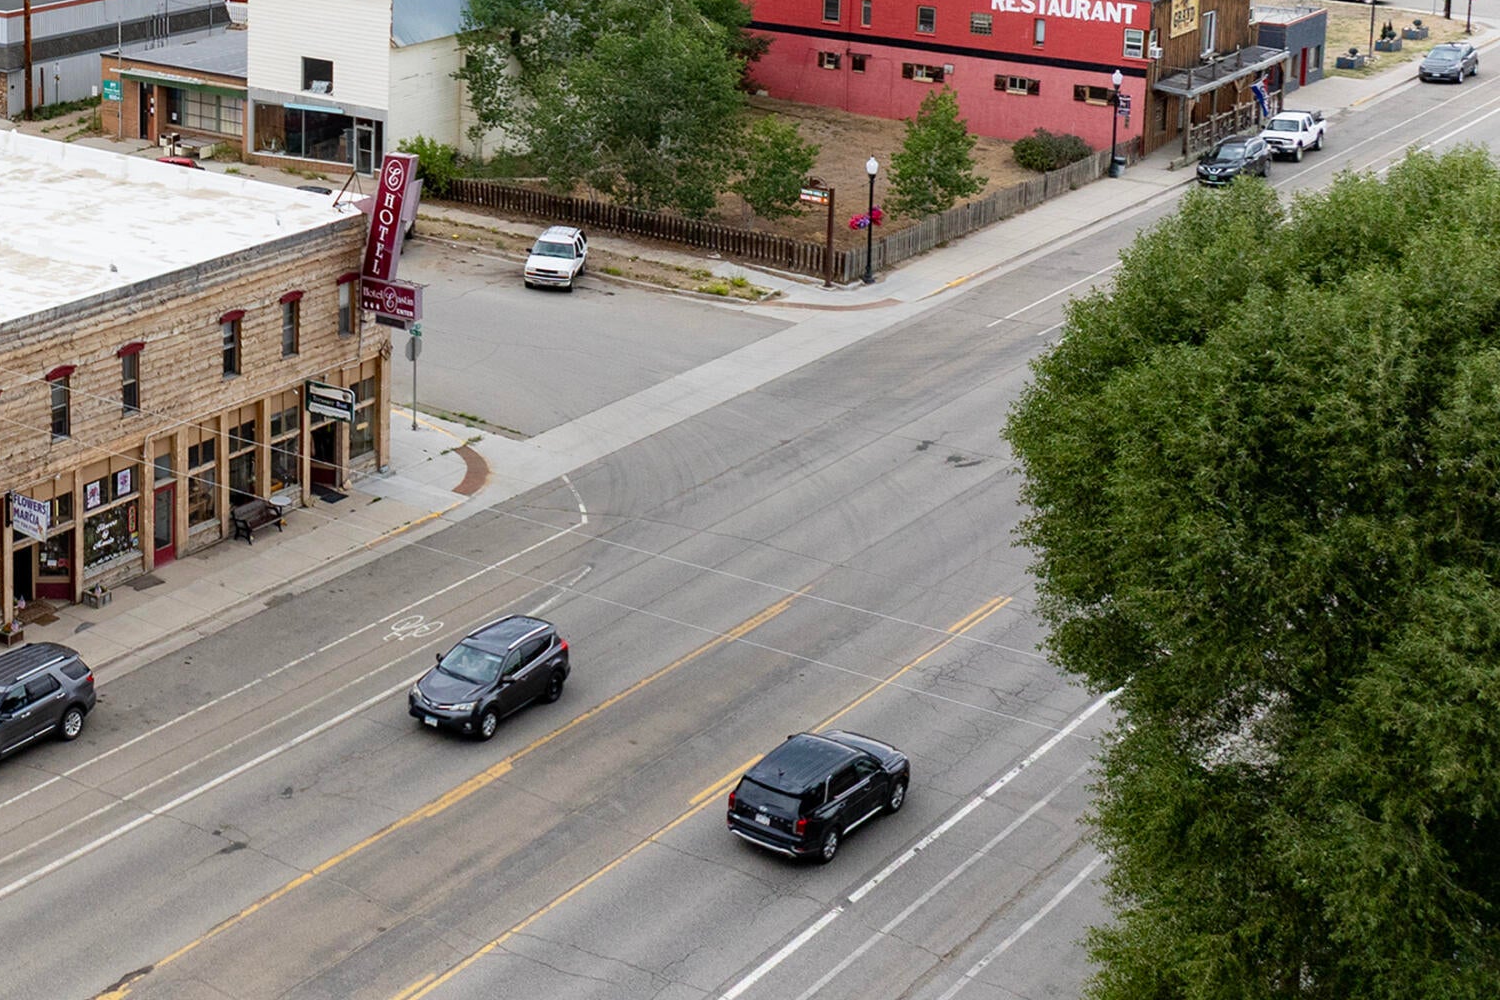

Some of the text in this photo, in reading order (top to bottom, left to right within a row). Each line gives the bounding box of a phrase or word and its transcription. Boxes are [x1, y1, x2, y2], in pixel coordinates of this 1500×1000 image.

[372, 192, 395, 275] HOTEL
[363, 286, 384, 300] Hotel
[13, 494, 46, 515] FLOWERS
[13, 507, 40, 525] MARCIA
